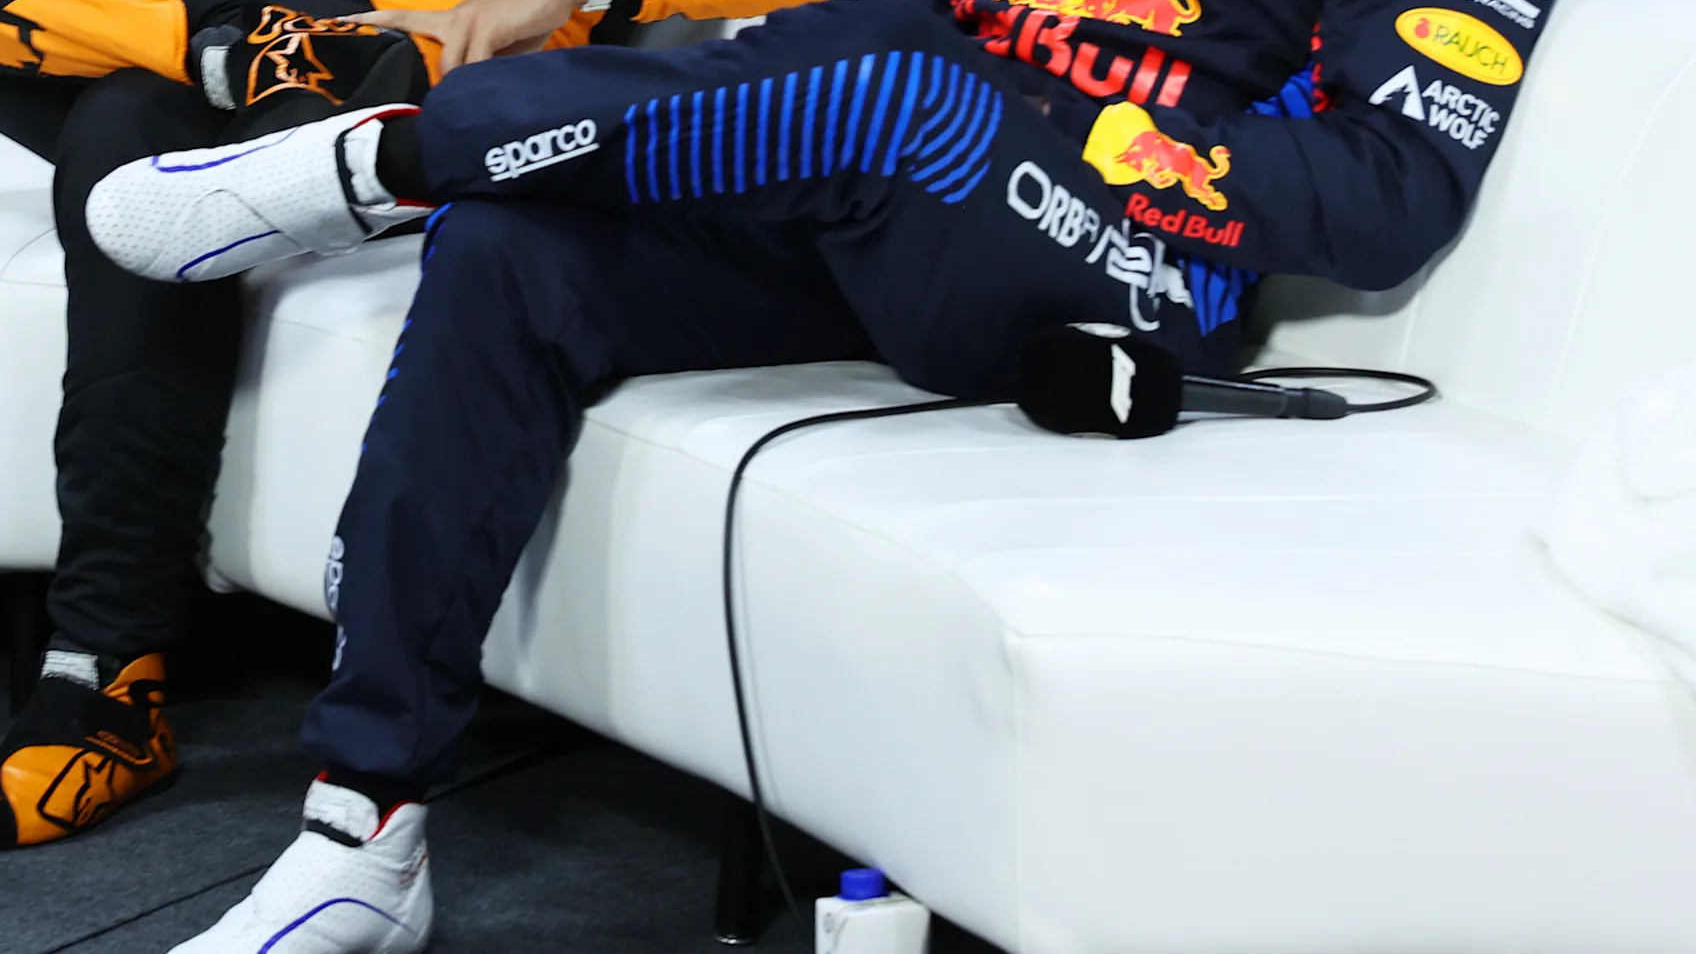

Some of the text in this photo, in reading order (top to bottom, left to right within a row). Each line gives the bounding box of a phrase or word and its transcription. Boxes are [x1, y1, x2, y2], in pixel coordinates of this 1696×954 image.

[1015, 8, 1193, 109] Bull
[1431, 24, 1509, 76] RAUCH
[1421, 78, 1502, 135] ARCTIC
[1428, 103, 1489, 151] WOLF
[485, 117, 599, 179] sparco
[1123, 192, 1246, 248] Red Bull
